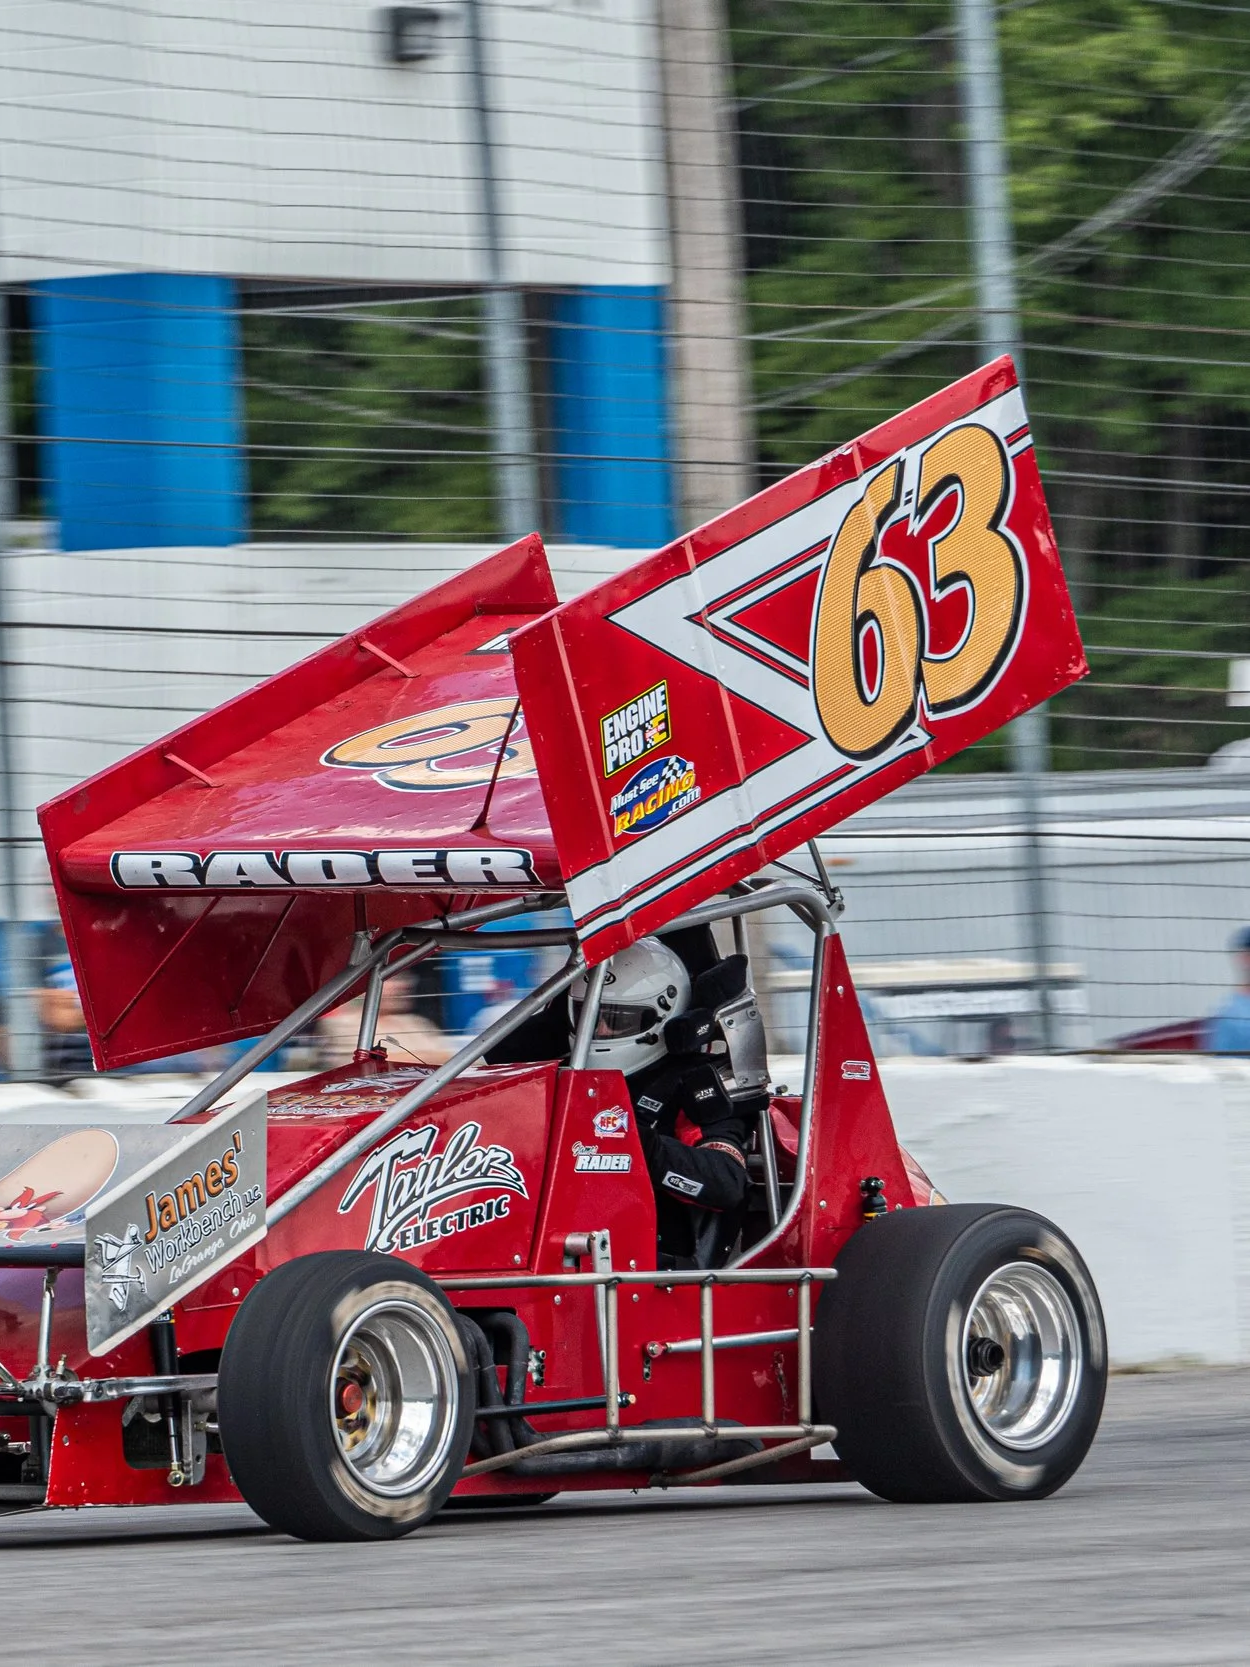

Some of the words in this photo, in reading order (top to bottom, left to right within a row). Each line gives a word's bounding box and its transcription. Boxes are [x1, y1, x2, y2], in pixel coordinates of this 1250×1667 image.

[810, 423, 1028, 760] 63
[603, 685, 666, 746] ENGINE
[606, 729, 644, 773] PRO
[611, 785, 638, 812] Must
[639, 773, 660, 795] See
[615, 770, 696, 835] RACING
[668, 788, 700, 815] .com
[112, 851, 543, 888] RADER
[145, 1130, 242, 1244] James'
[338, 1122, 527, 1252] Taylor
[575, 1154, 631, 1172] RADER
[144, 1190, 241, 1273] Workbench
[244, 1185, 262, 1207] LLC
[230, 1212, 257, 1238] Ohio
[399, 1195, 510, 1251] ELECTRIC
